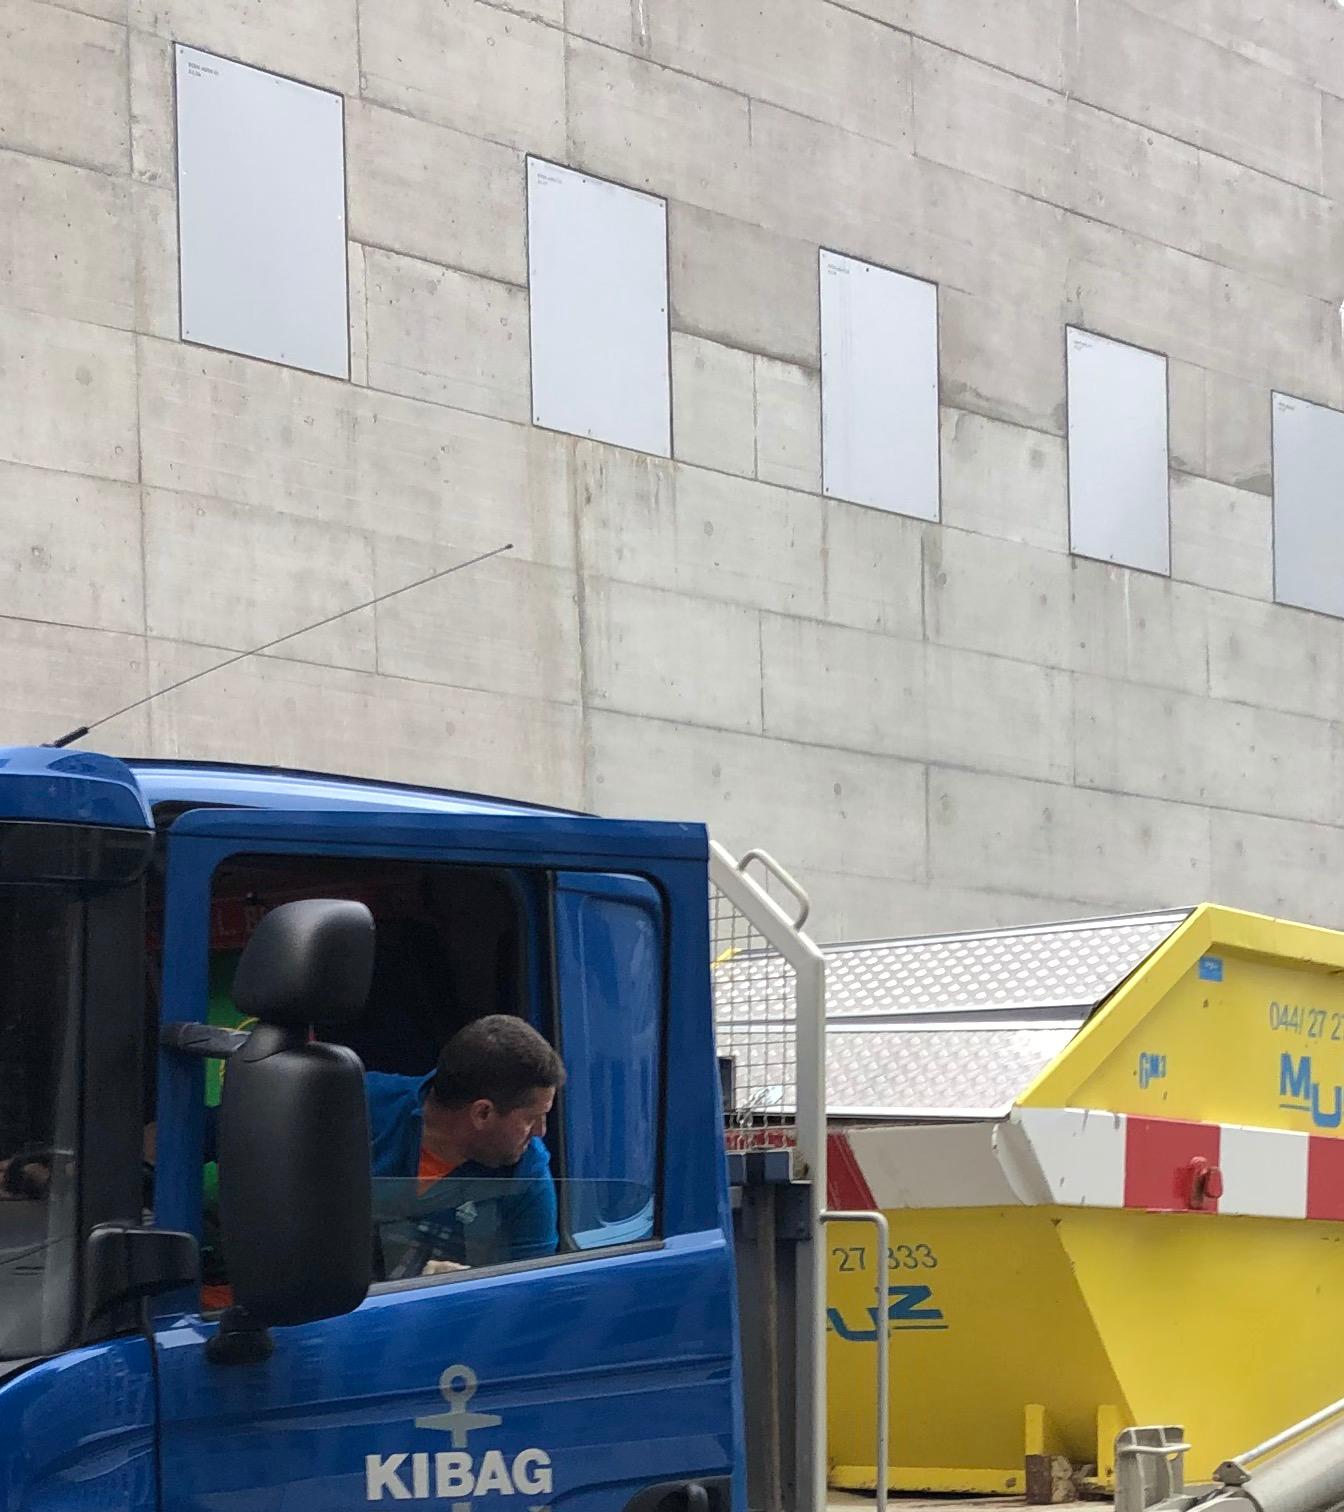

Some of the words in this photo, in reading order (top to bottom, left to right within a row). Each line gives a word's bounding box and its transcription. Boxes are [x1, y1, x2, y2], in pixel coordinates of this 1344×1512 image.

[832, 1246, 865, 1271] 27
[827, 1284, 944, 1342] UZ
[365, 1447, 554, 1501] KIBAG
